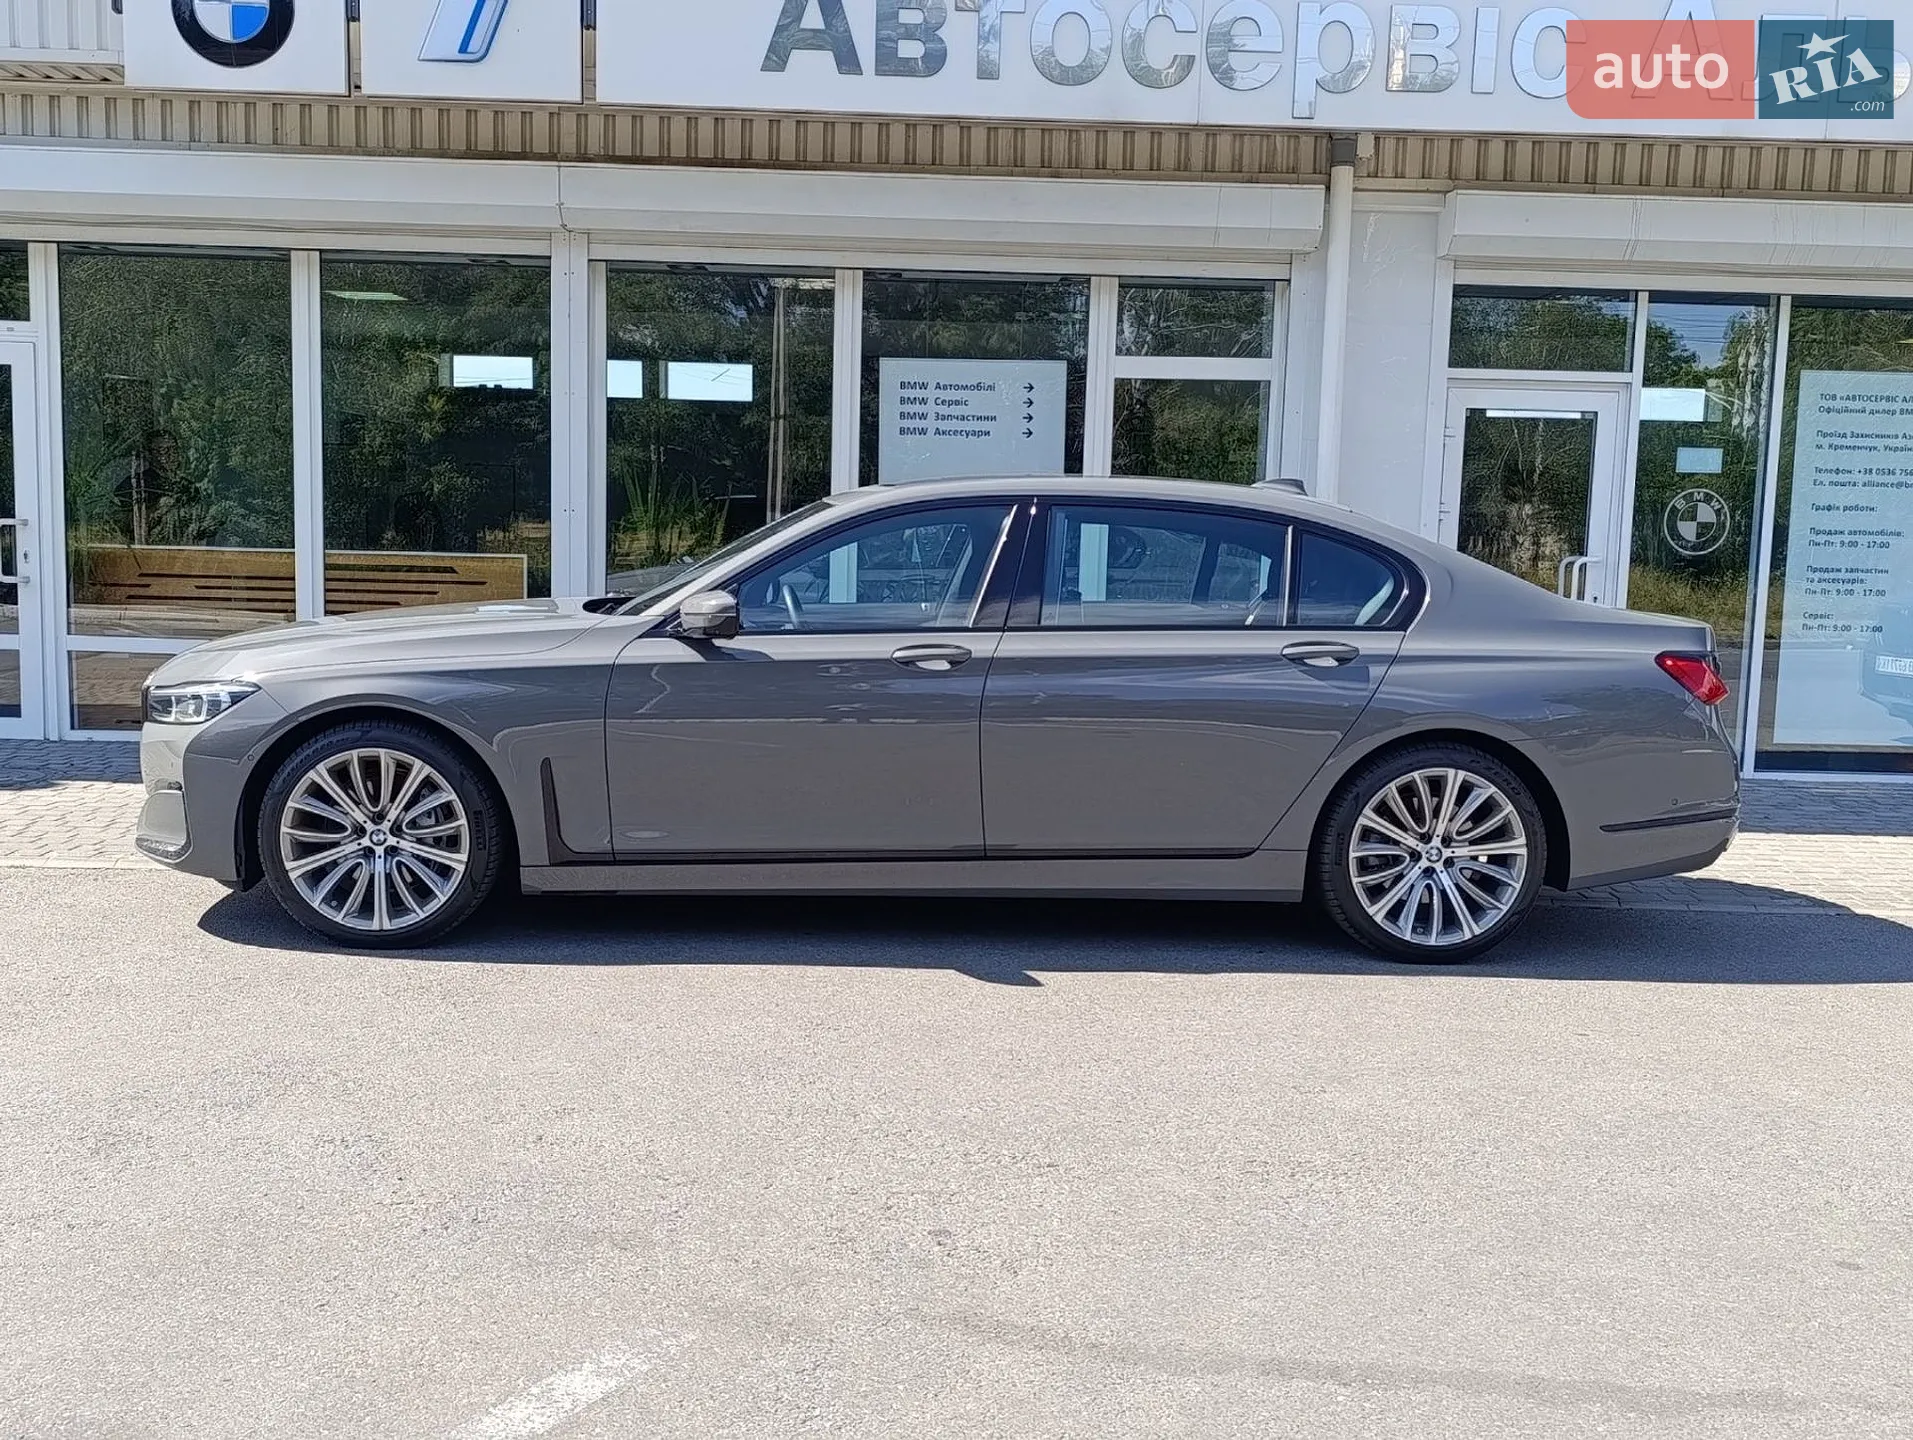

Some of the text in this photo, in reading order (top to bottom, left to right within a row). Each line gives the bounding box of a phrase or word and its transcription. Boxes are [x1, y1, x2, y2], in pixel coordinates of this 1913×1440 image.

[899, 381, 996, 392] BMW Автомобілі
[899, 396, 969, 408] BMW Сервіс
[1820, 393, 1838, 402] ТОВ
[899, 411, 997, 422] BMW Запчастини
[1818, 405, 1867, 417] Офіційний
[1868, 408, 1897, 417] дилер
[899, 426, 991, 439] BMW Аксесуари
[1816, 430, 1848, 440] Проїзд
[1814, 466, 1856, 475] Телефон:
[1857, 467, 1874, 476] +38
[1875, 467, 1897, 476] 0536
[1674, 492, 1722, 510] BMW
[1809, 527, 1905, 538] Продаж автомобілів:
[1839, 540, 1859, 549] 9:00
[1866, 541, 1891, 549] 17:00
[1806, 565, 1842, 575] Продаж
[1835, 588, 1855, 597] 9:00
[1862, 588, 1887, 598] 17:00
[1802, 611, 1835, 621] Сервіс:
[1832, 623, 1852, 633] 9:00
[1859, 624, 1884, 634] 17:00
